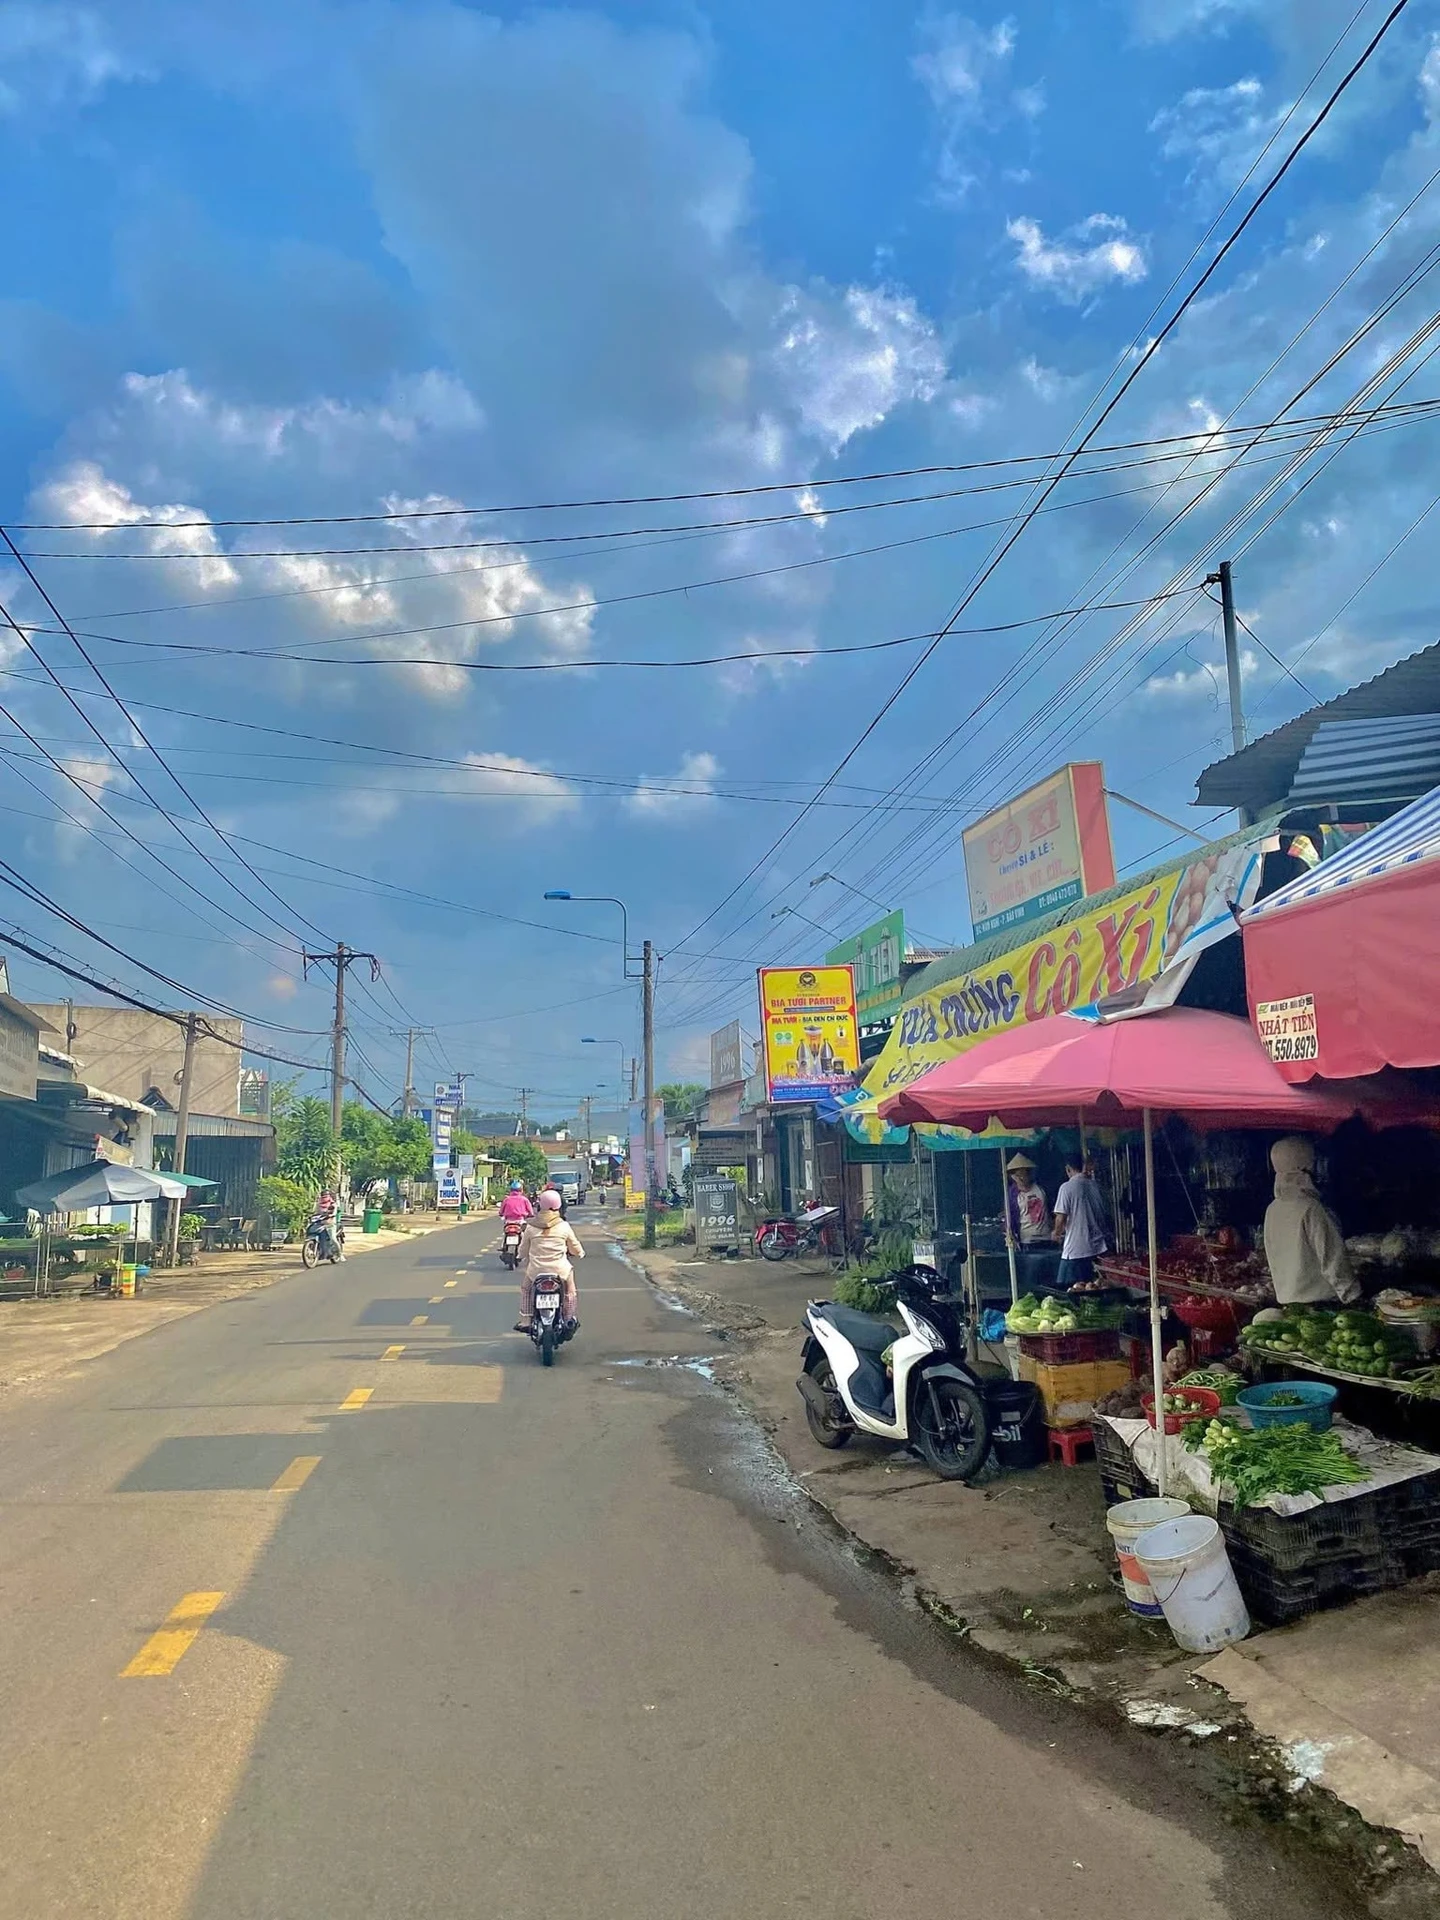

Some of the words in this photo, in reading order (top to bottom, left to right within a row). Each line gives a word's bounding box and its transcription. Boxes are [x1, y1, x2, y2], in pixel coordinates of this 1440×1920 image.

[940, 970, 1021, 1040] TRỨNG
[1024, 928, 1083, 1023] Cô
[771, 999, 785, 1007] BIA
[808, 996, 847, 1006] PARTNER
[1262, 1034, 1317, 1061] 7.550.8979
[720, 1049, 736, 1074] 1996
[442, 1177, 456, 1186] NHÀ
[439, 1187, 460, 1198] THUỐC
[700, 1214, 736, 1227] 1996
